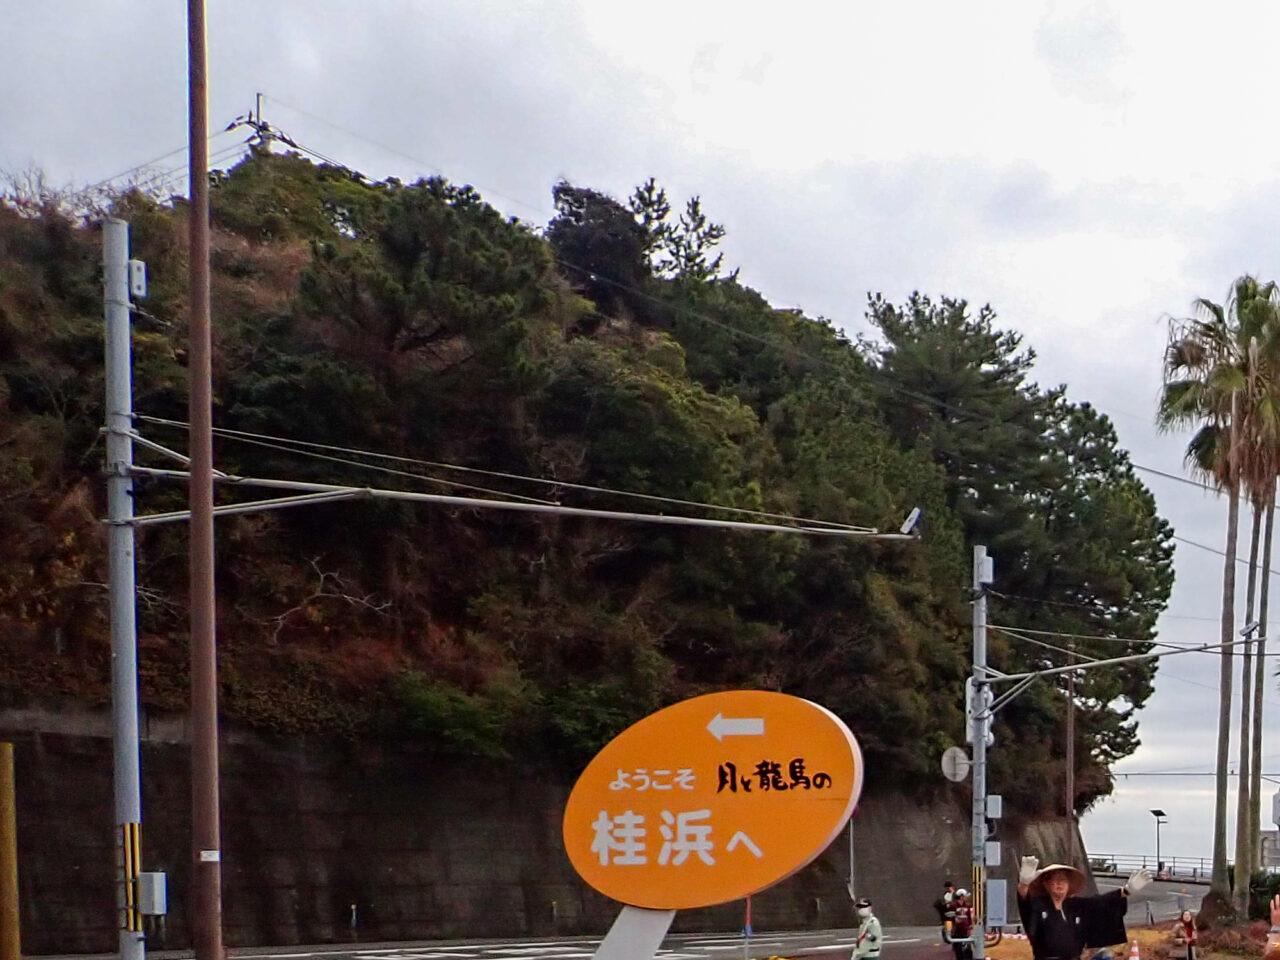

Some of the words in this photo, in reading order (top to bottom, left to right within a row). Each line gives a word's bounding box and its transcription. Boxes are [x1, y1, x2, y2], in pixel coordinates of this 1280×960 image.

[609, 769, 695, 791] ようこそ
[716, 758, 832, 793] 月と龍馬の
[591, 809, 763, 866] 桂浜へ
